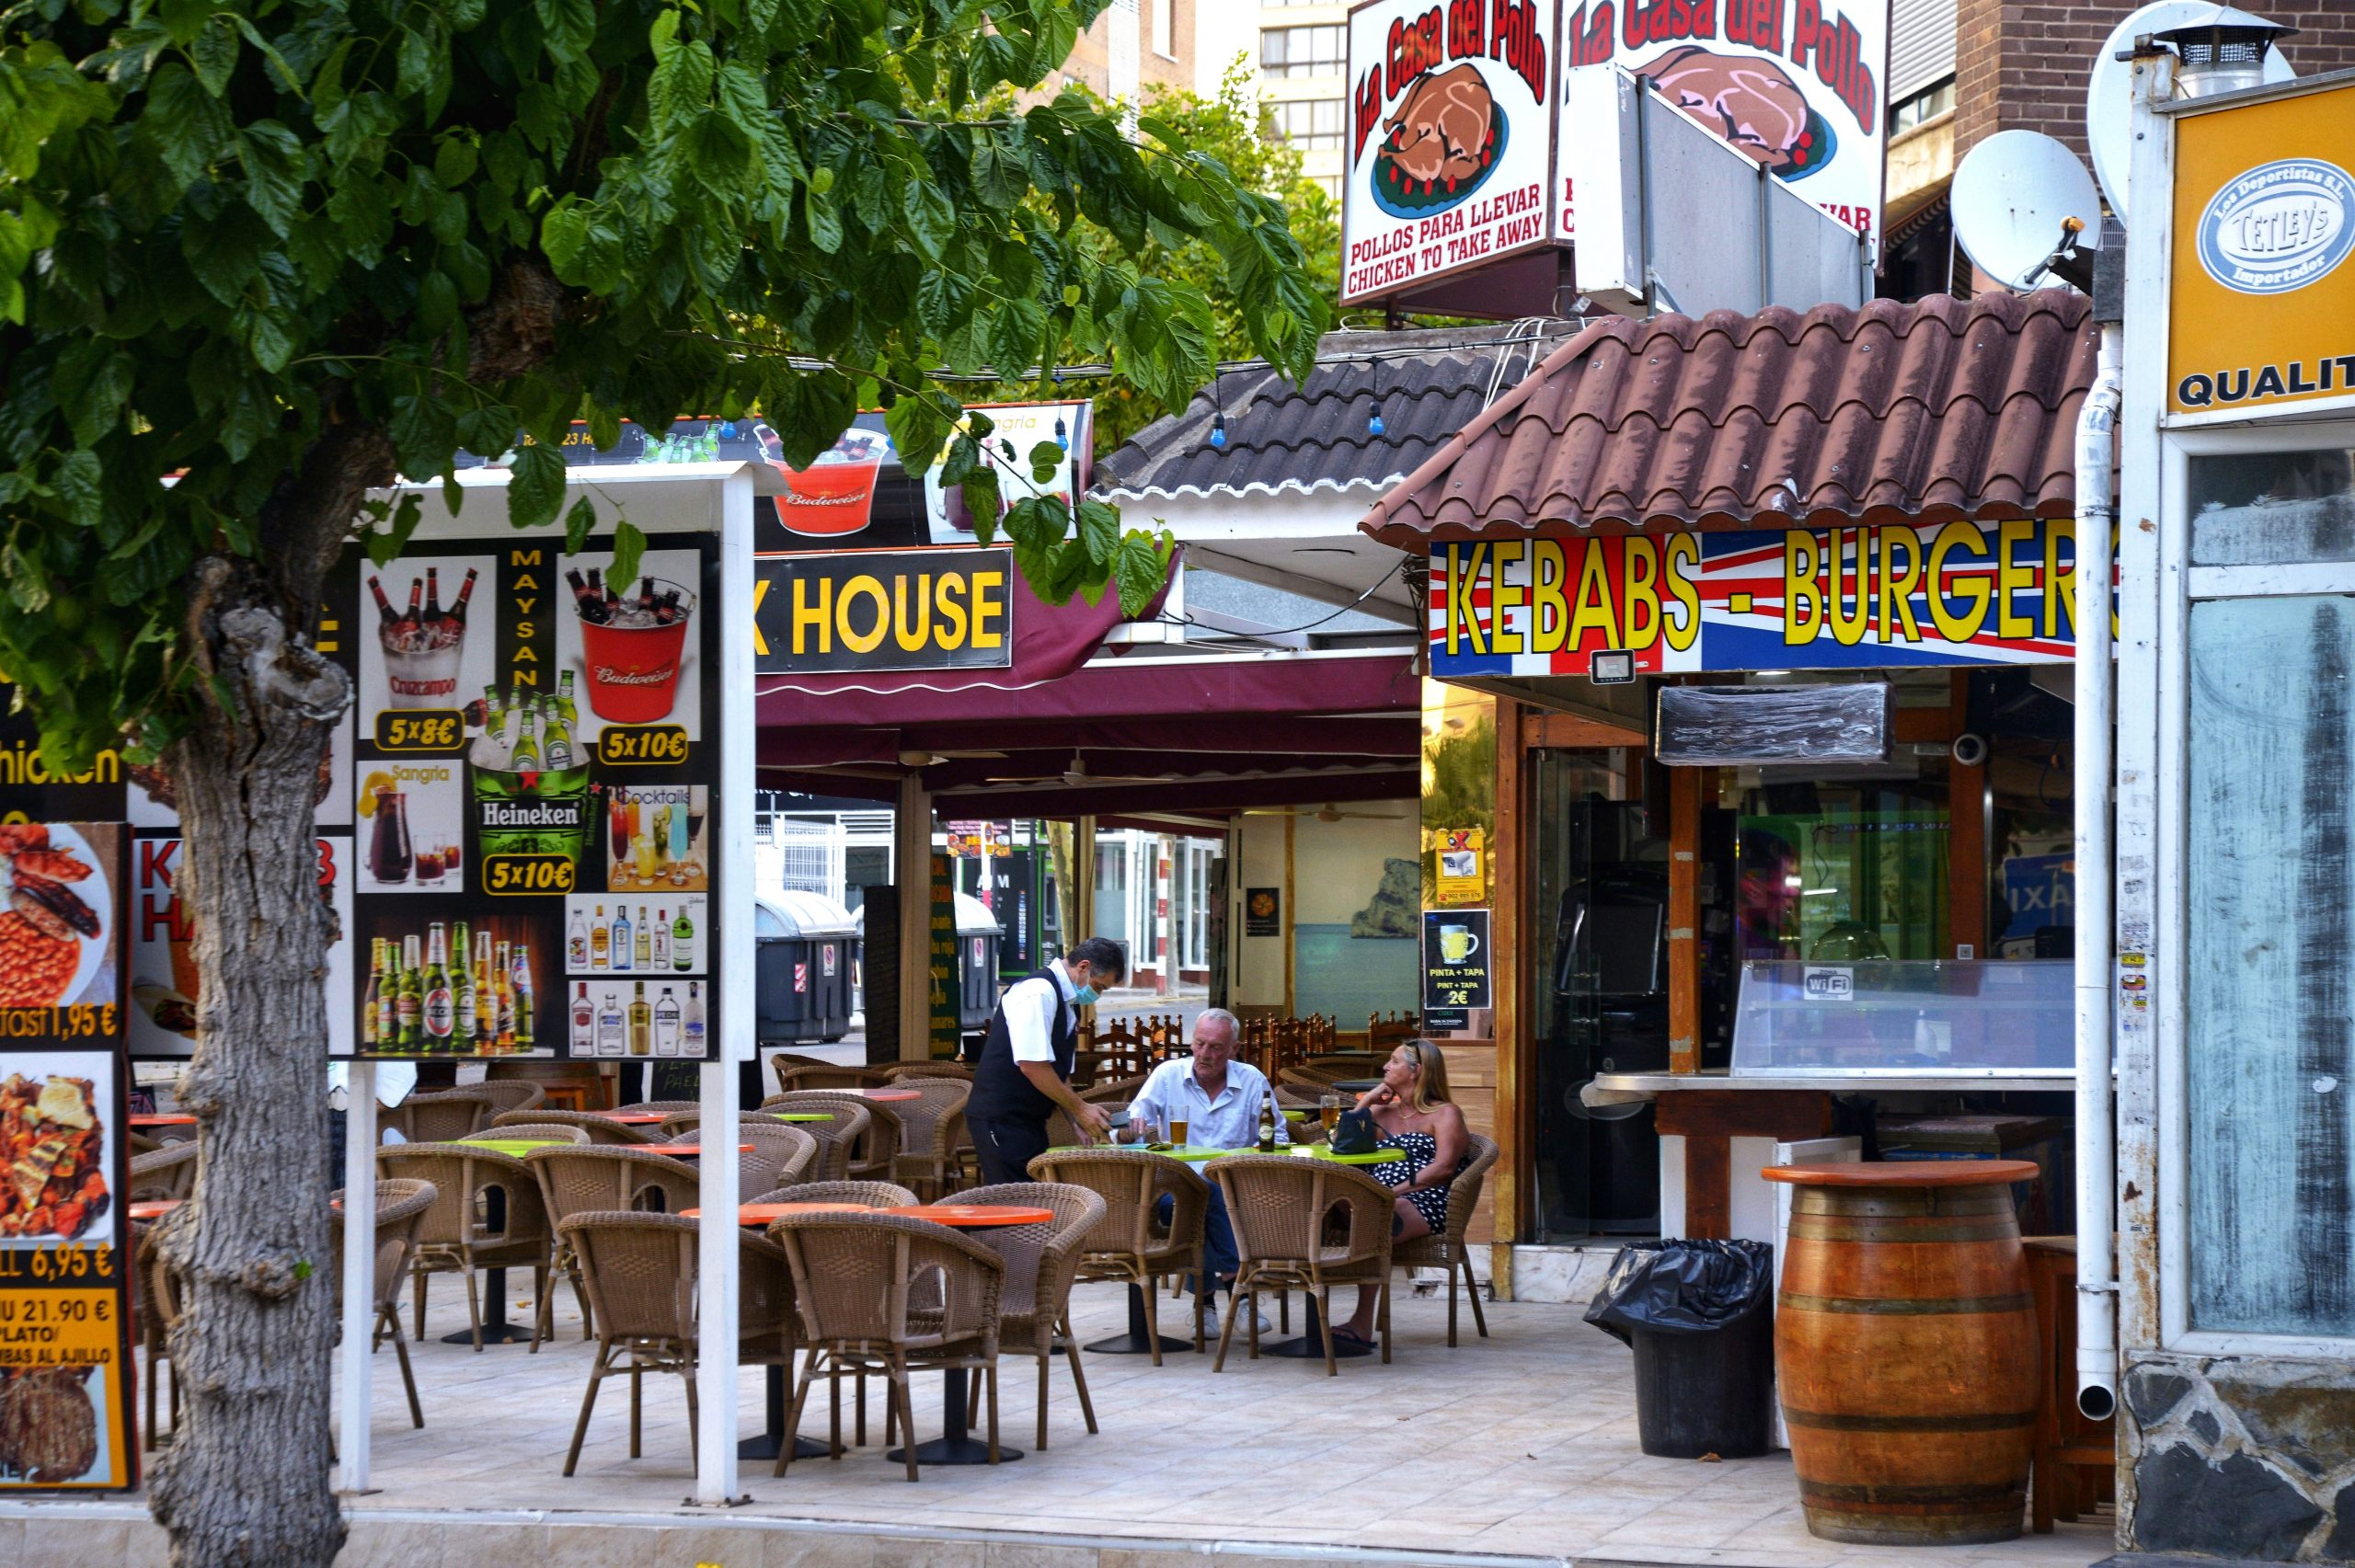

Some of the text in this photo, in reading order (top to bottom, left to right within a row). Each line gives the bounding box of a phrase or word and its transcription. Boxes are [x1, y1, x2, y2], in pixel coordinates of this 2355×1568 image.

[1623, 0, 1717, 51] Casa
[1725, 0, 1784, 57] del
[1791, 0, 1877, 136] Pollo
[1355, 0, 1545, 173] La Casa del Pollo
[2213, 192, 2238, 222] Los
[2237, 167, 2323, 196] Deportistas
[1350, 225, 1414, 266] POLLOS
[1419, 209, 1464, 244] PARA
[1471, 184, 1540, 228] LLEVAR
[1349, 253, 1416, 294] CHICKEN
[1421, 244, 1442, 271] TO
[1448, 229, 1490, 262] TAKE
[1496, 212, 1543, 247] AWAY
[2233, 255, 2326, 287] Importador
[2178, 355, 2355, 406] QUALIT
[994, 416, 1037, 432] ngria
[562, 433, 580, 446] 23
[787, 491, 867, 507] Budweiser
[1445, 532, 1702, 656] KEBABS
[1784, 518, 2120, 647] BURGER
[511, 549, 542, 687] MAYSAN
[793, 570, 1003, 657] HOUSE
[390, 675, 456, 697] Cruzcampo
[595, 664, 674, 686] Budweiser
[387, 718, 456, 746] 5x8€
[606, 730, 686, 759] 5x10€
[391, 763, 450, 785] Sangria
[617, 788, 691, 806] Cocktails
[483, 802, 580, 826] Heineken
[490, 861, 571, 889] 5x10€
[977, 875, 1010, 889] AM
[1430, 968, 1455, 977] PINTA
[1464, 968, 1485, 977] TAPA
[1448, 990, 1468, 1005] 2€
[101, 1001, 118, 1036] €
[31, 1242, 89, 1282] 6,95
[94, 1242, 115, 1277] €
[23, 1299, 87, 1322] 21.90
[96, 1299, 109, 1322] €
[37, 1348, 55, 1363] AL
